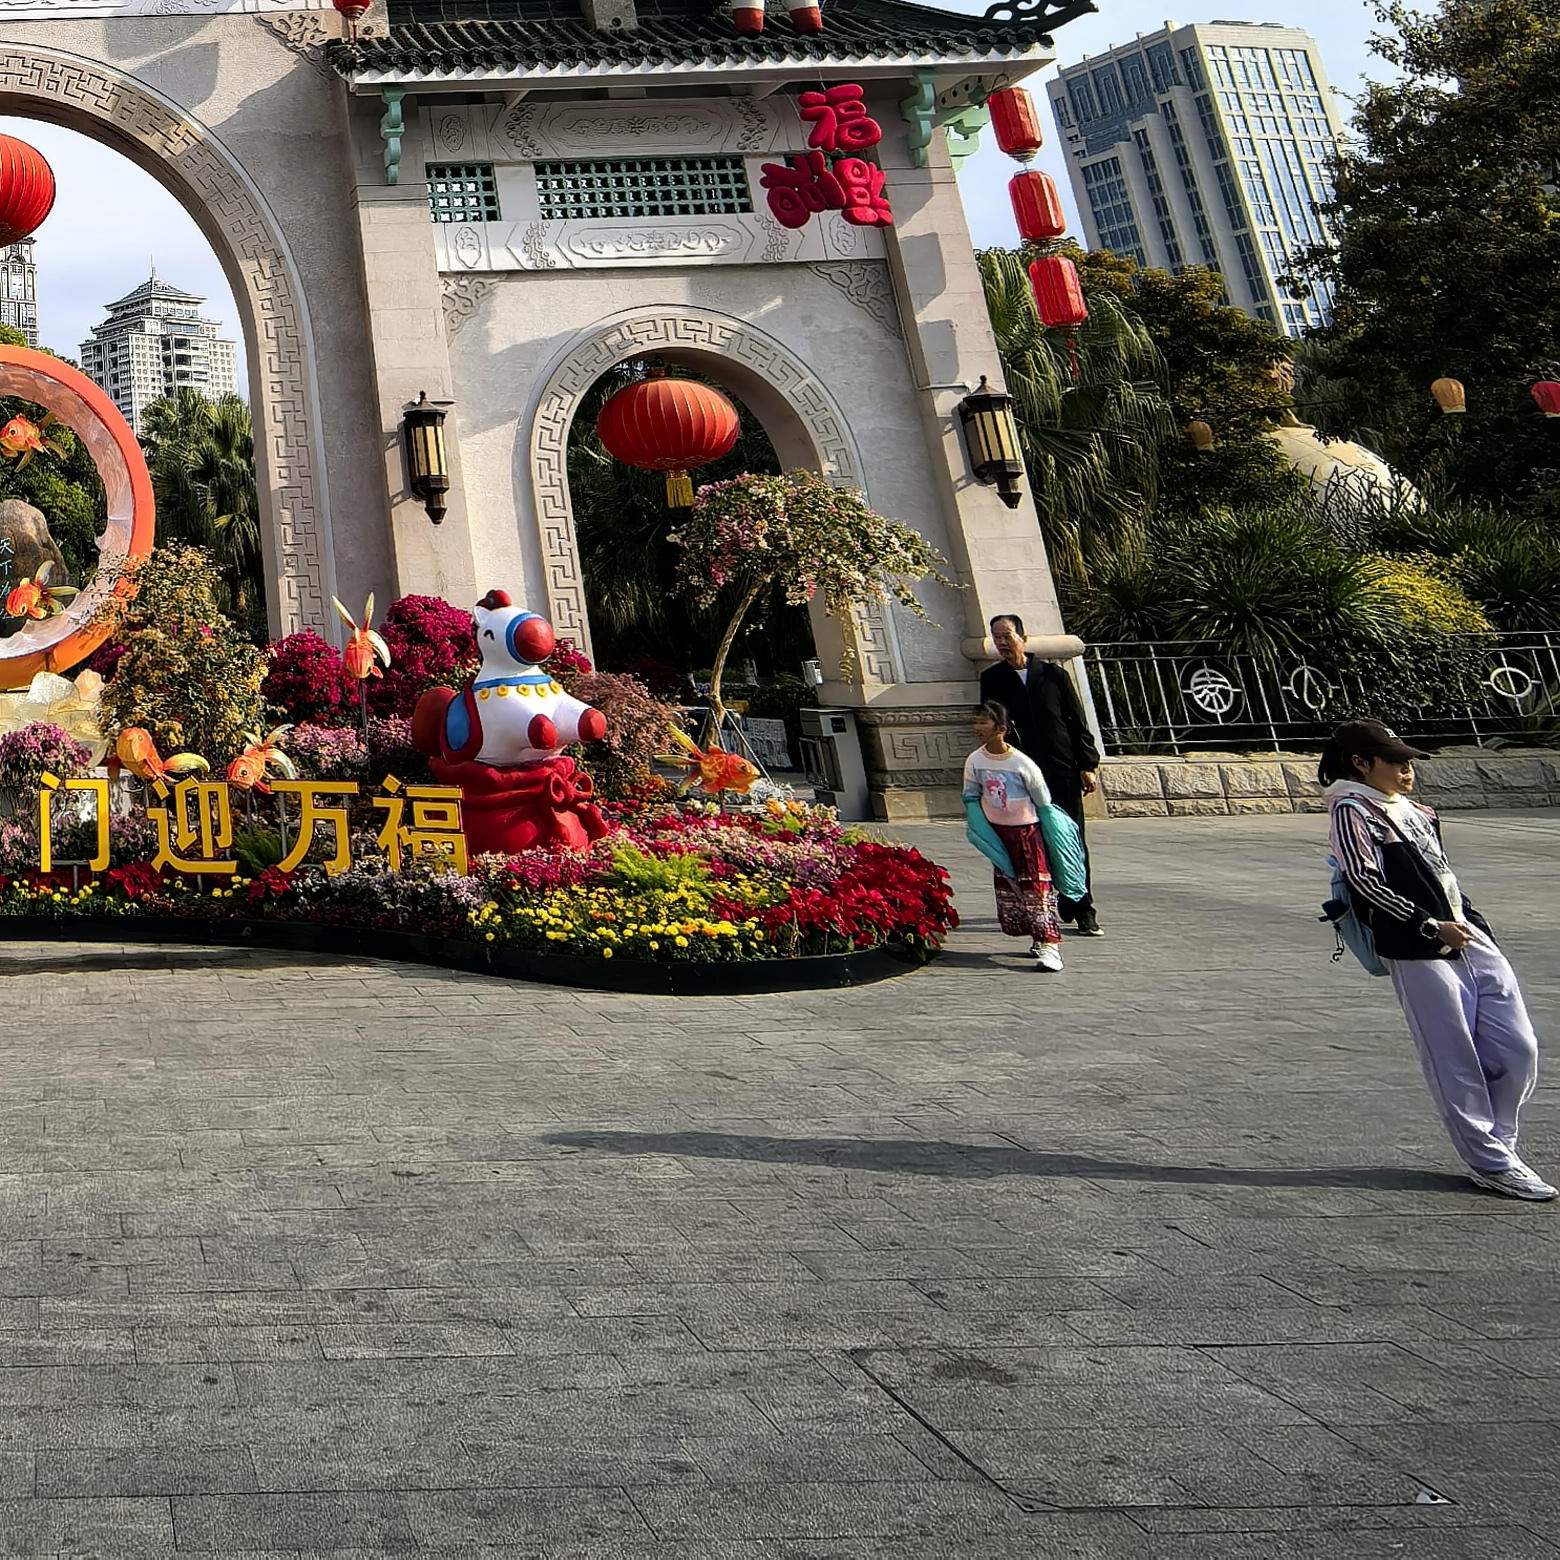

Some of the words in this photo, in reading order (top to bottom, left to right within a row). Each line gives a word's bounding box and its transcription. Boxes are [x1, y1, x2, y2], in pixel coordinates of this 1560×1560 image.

[798, 83, 883, 152] 福
[39, 772, 470, 877] 门迎万福
